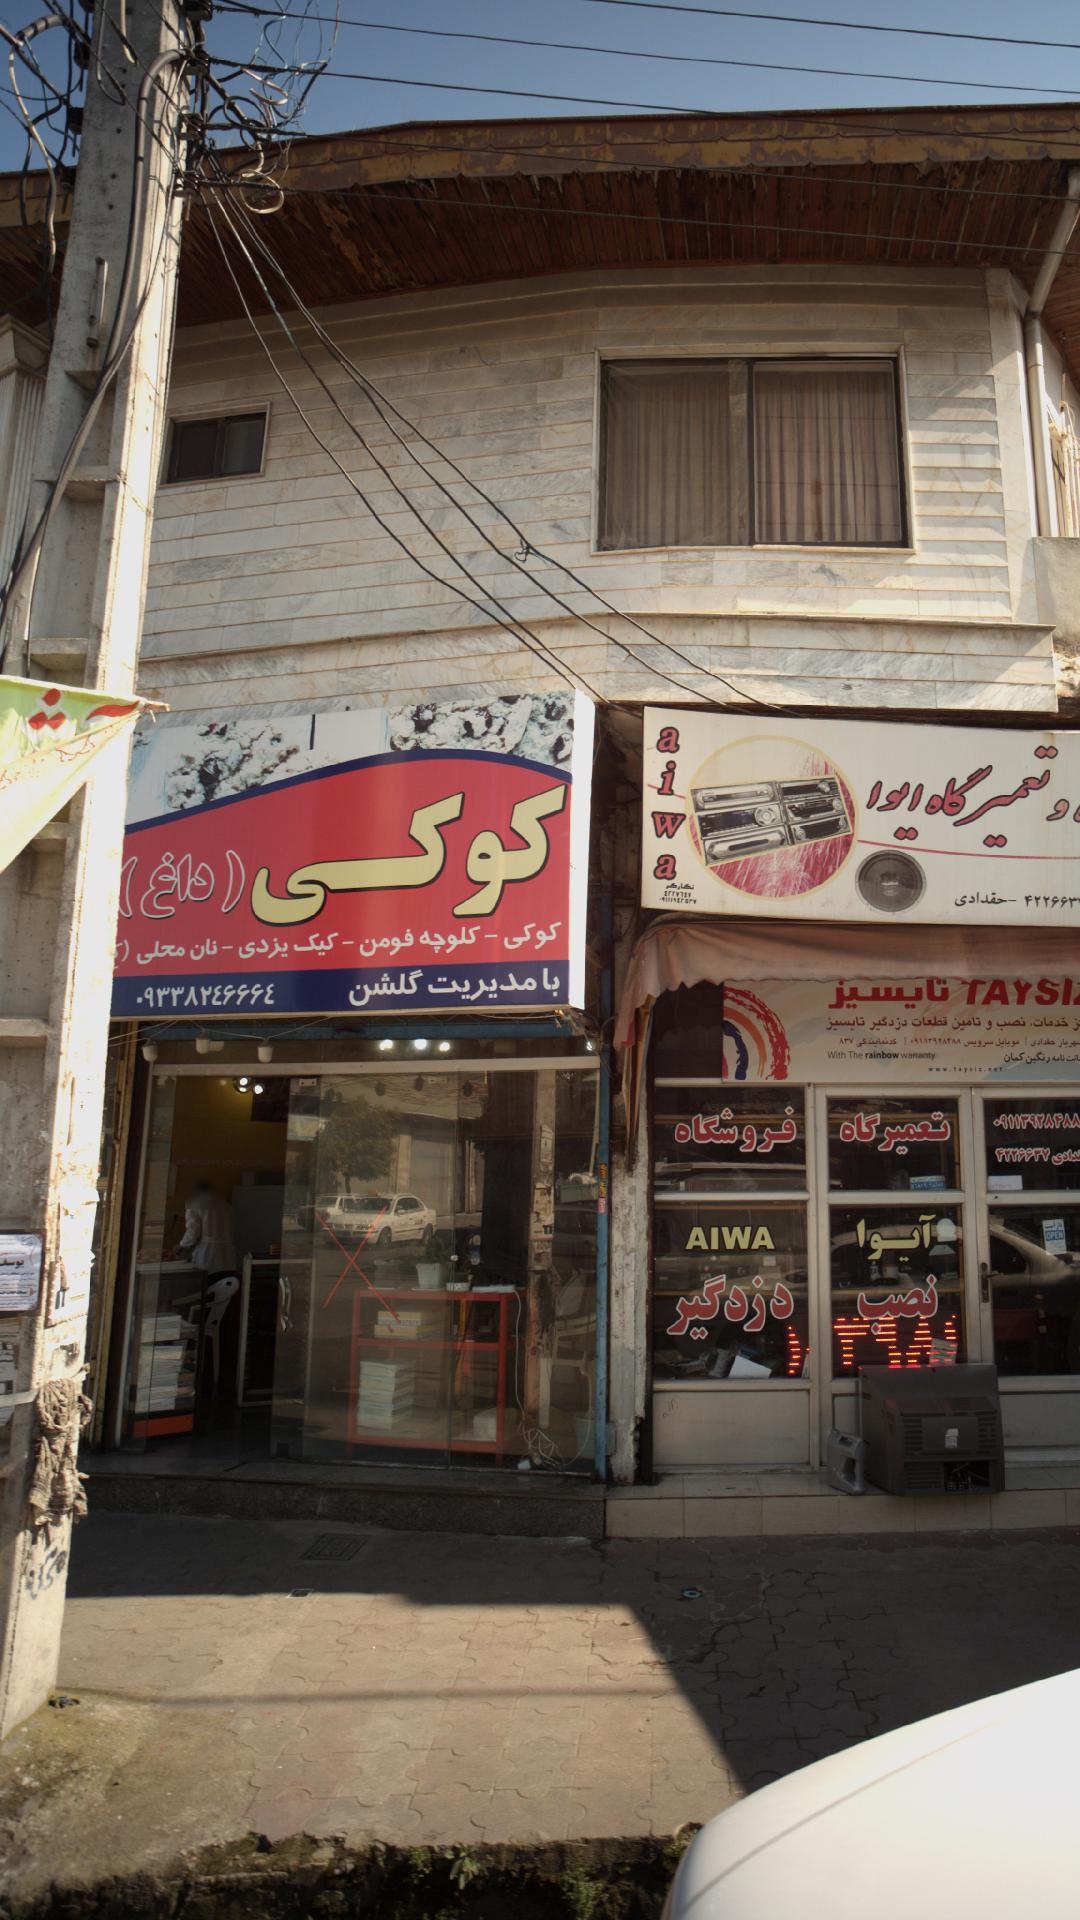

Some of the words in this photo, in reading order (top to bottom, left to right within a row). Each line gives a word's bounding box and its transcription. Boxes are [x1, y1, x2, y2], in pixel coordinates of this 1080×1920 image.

[925, 745, 1059, 848] تعمیرگاه
[866, 780, 924, 840] ایوا
[1046, 799, 1070, 822] و
[251, 783, 568, 927] کوکی
[238, 938, 290, 960] یزدی
[293, 932, 339, 956] کیک
[359, 928, 415, 957] فومن
[419, 926, 481, 954] کلوچه
[503, 922, 562, 950] کوکی
[136, 941, 186, 965] محلی
[189, 938, 219, 961] نان
[349, 969, 424, 1007] گلشن
[427, 971, 538, 1001] مدیریت
[542, 967, 561, 998] با
[826, 1016, 866, 1031] تایسیز
[869, 1017, 908, 1031] دزدگیر
[911, 1015, 948, 1027] قطعات
[951, 1017, 982, 1031] تامین
[985, 1019, 993, 1031] و
[996, 1016, 1026, 1031] نصب
[827, 1051, 847, 1059] With
[848, 1051, 863, 1059] The
[864, 1050, 899, 1060] rainbow
[1003, 1052, 1025, 1063] کمان
[674, 1107, 797, 1152] فروشگاه
[839, 1112, 951, 1155] تعمیرگاه
[684, 1226, 776, 1251] AIWA
[855, 1214, 936, 1263] آیوا
[666, 1273, 795, 1340] دزدگیر
[856, 1273, 939, 1336] نصب
